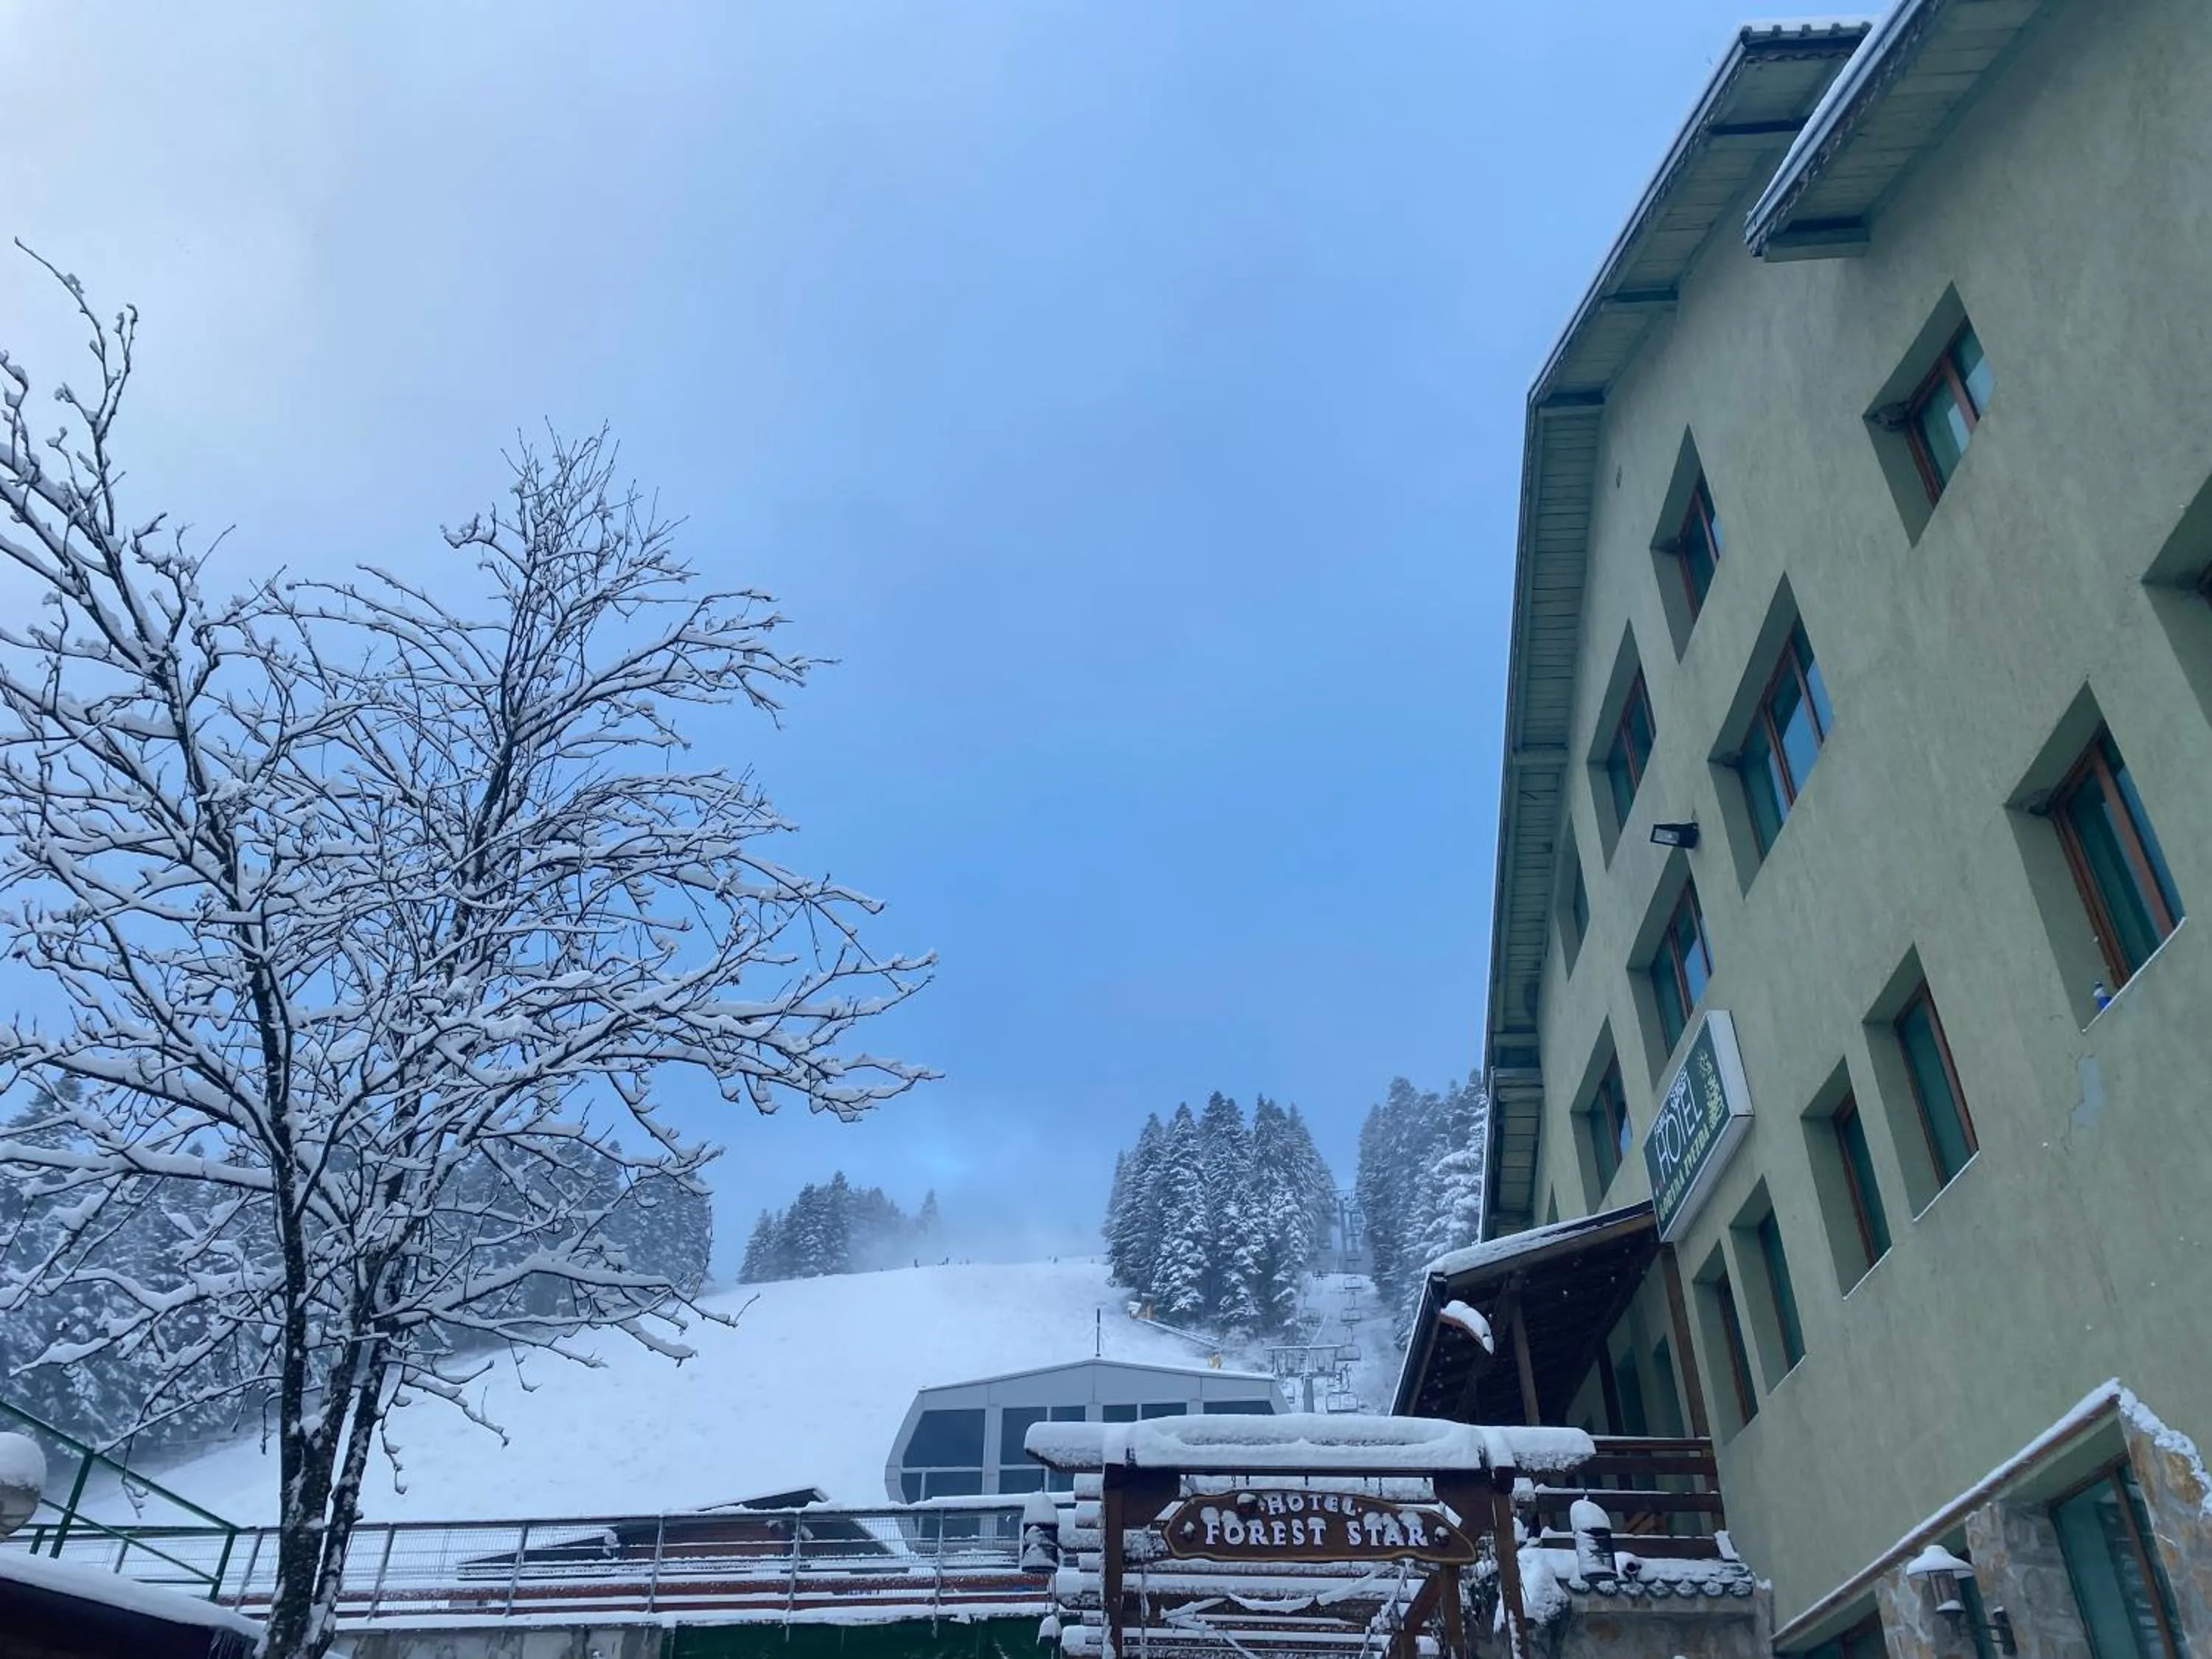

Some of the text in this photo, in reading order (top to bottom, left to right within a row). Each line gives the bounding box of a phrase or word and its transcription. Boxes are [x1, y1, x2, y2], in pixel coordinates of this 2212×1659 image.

[1656, 1074, 1703, 1184] HOTEL
[1267, 1494, 1356, 1516] HOTEL
[1205, 1520, 1428, 1546] FOREST STAR
